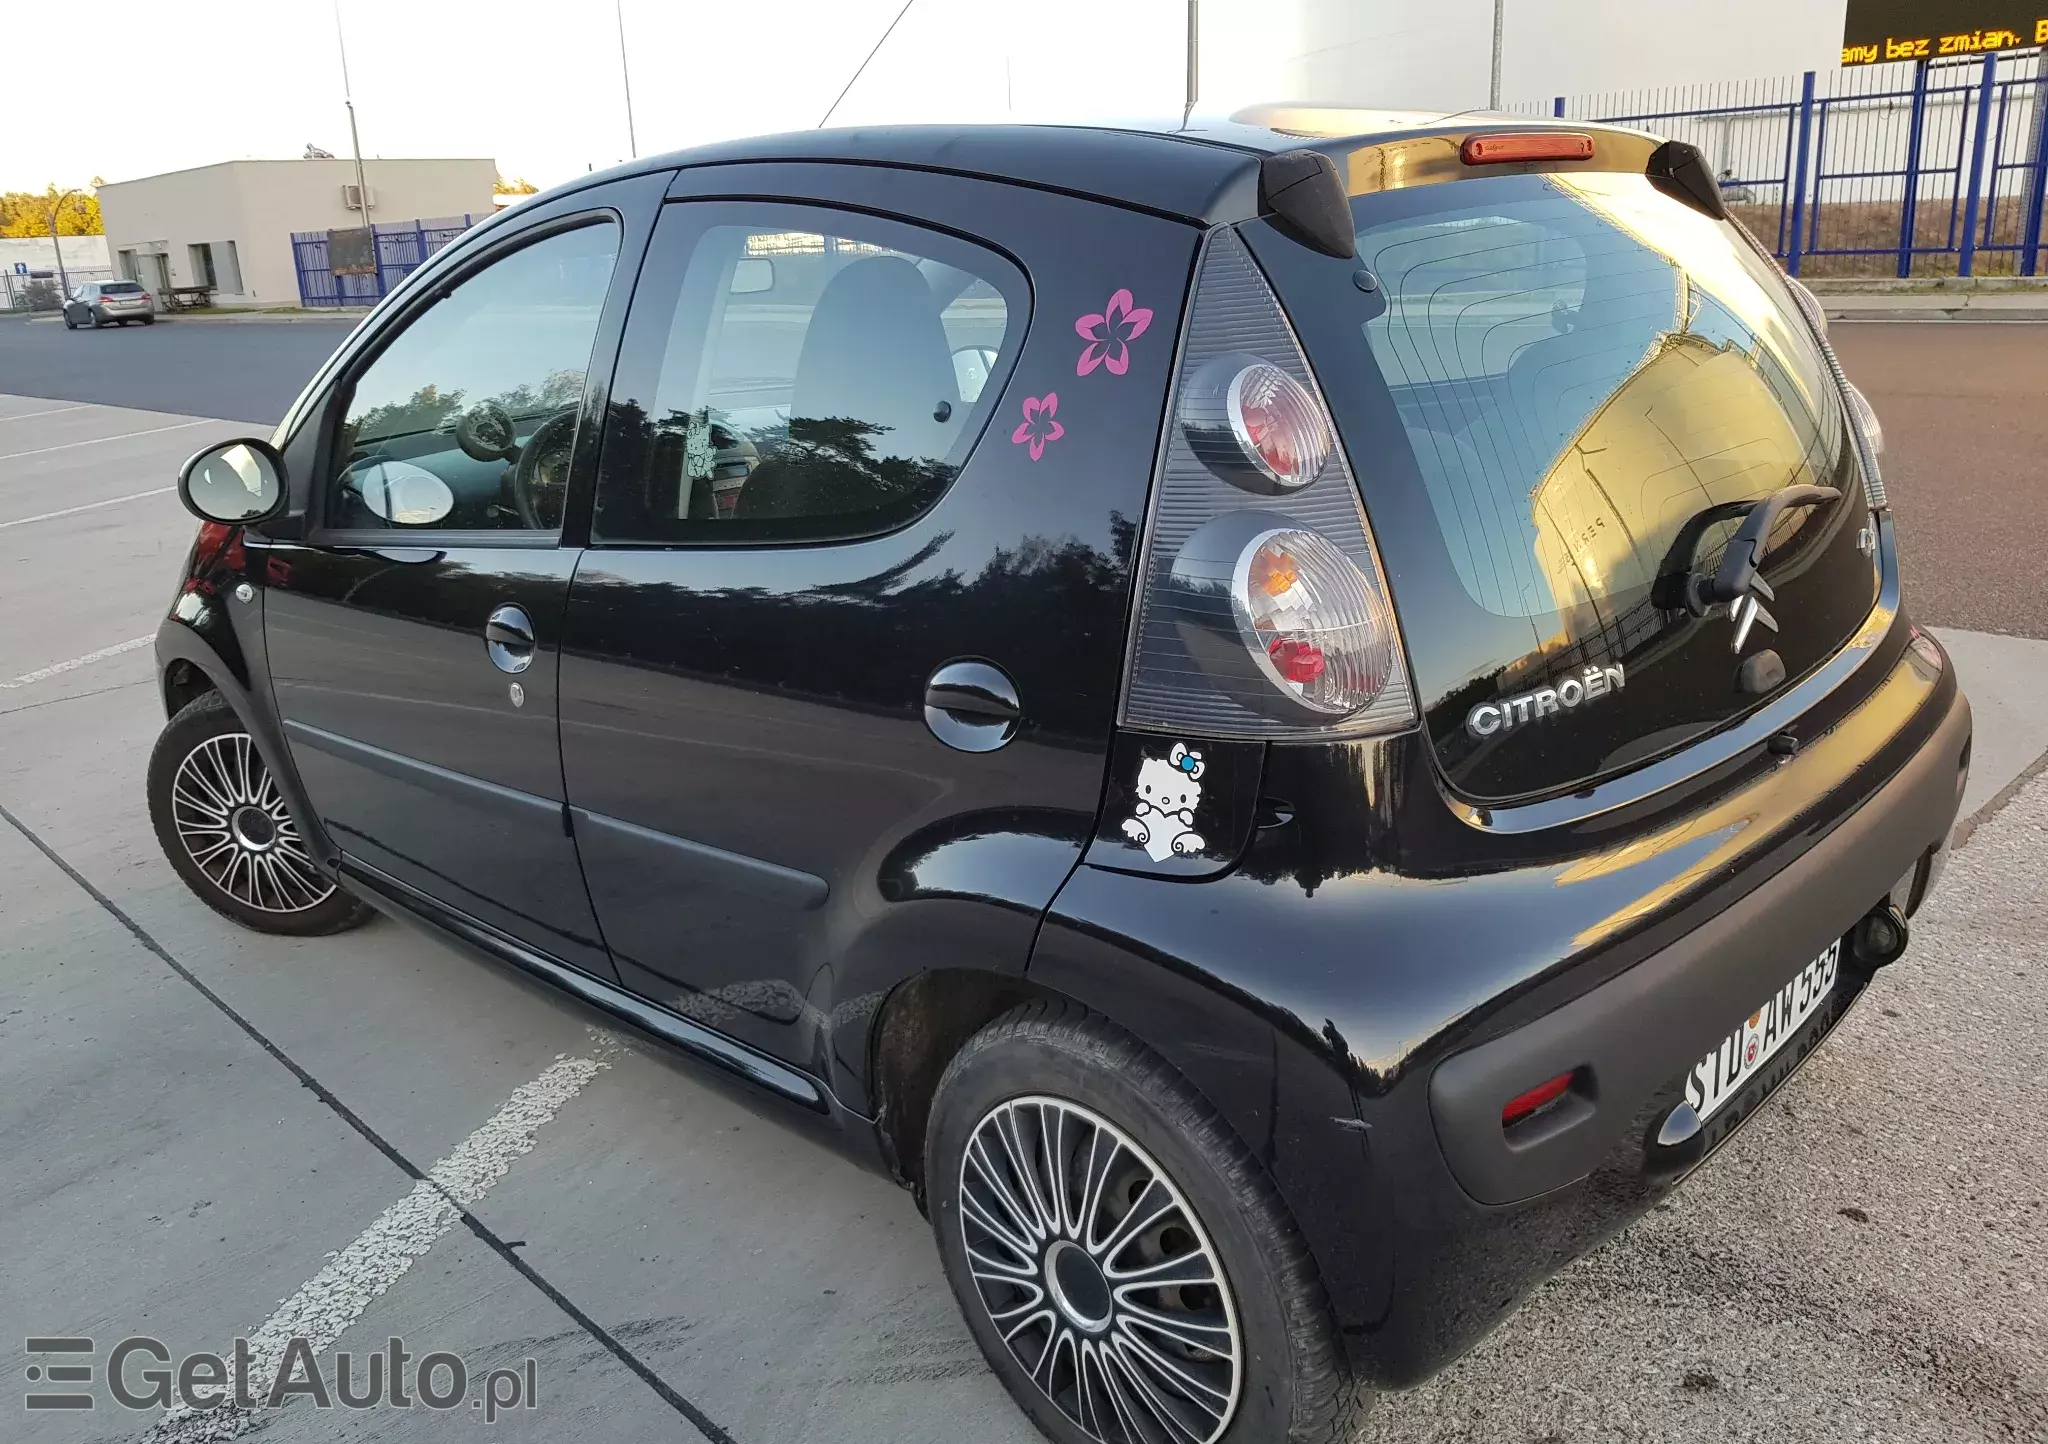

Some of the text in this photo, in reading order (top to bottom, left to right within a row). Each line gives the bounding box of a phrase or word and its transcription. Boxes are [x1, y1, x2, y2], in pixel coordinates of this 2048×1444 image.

[1886, 38, 1931, 59] bez
[1939, 30, 2022, 54] zmian.
[1468, 662, 1626, 736] CITROËN
[1762, 981, 1796, 1053] AW
